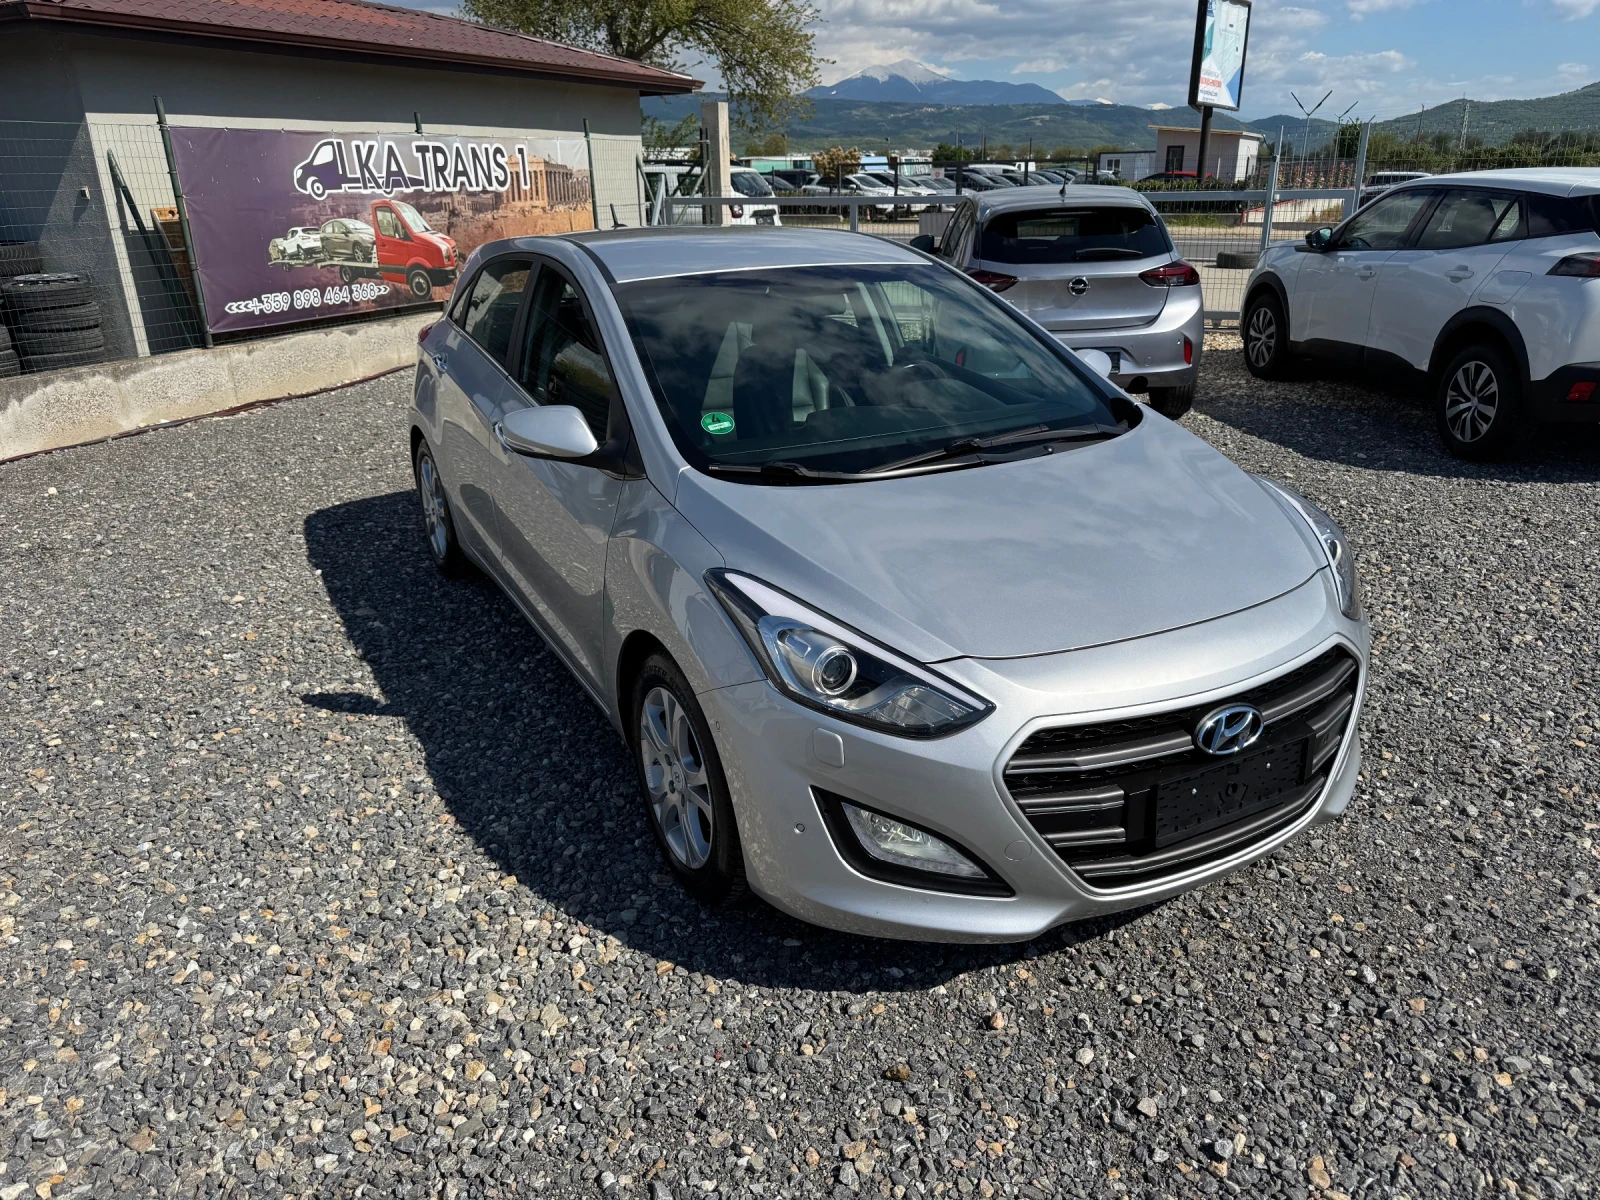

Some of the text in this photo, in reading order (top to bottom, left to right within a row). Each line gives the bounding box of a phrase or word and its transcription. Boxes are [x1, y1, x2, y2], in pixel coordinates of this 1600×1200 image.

[414, 143, 510, 189] TRANS
[516, 145, 530, 189] 1
[252, 283, 378, 314] +359 898 464 368
[712, 413, 721, 423] 4
